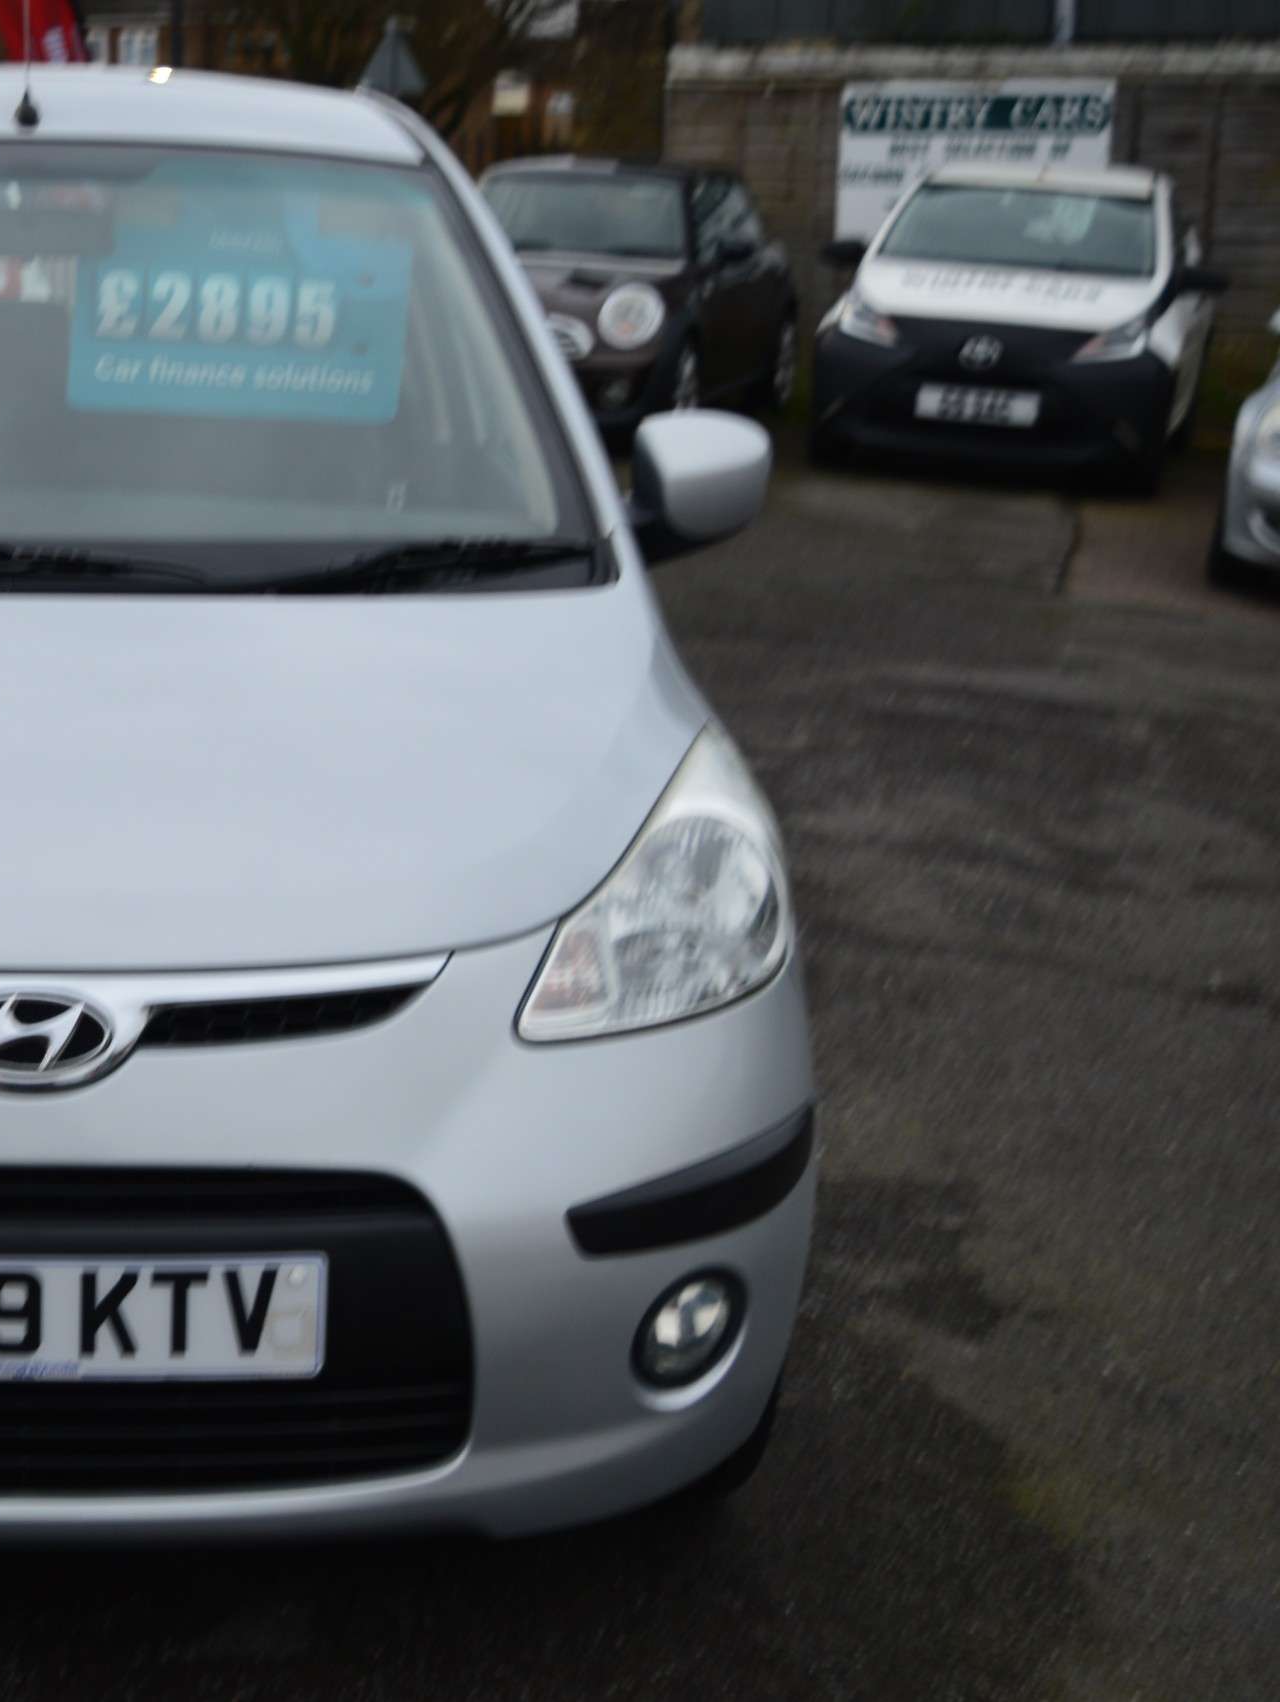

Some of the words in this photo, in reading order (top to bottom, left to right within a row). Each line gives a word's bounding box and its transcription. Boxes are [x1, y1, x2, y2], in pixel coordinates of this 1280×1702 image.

[1009, 97, 1112, 133] CARS
[95, 267, 337, 350] £2895
[93, 352, 141, 384] Car
[148, 353, 247, 390] finance
[253, 361, 375, 396] solutions
[78, 1267, 283, 1359] KTV
